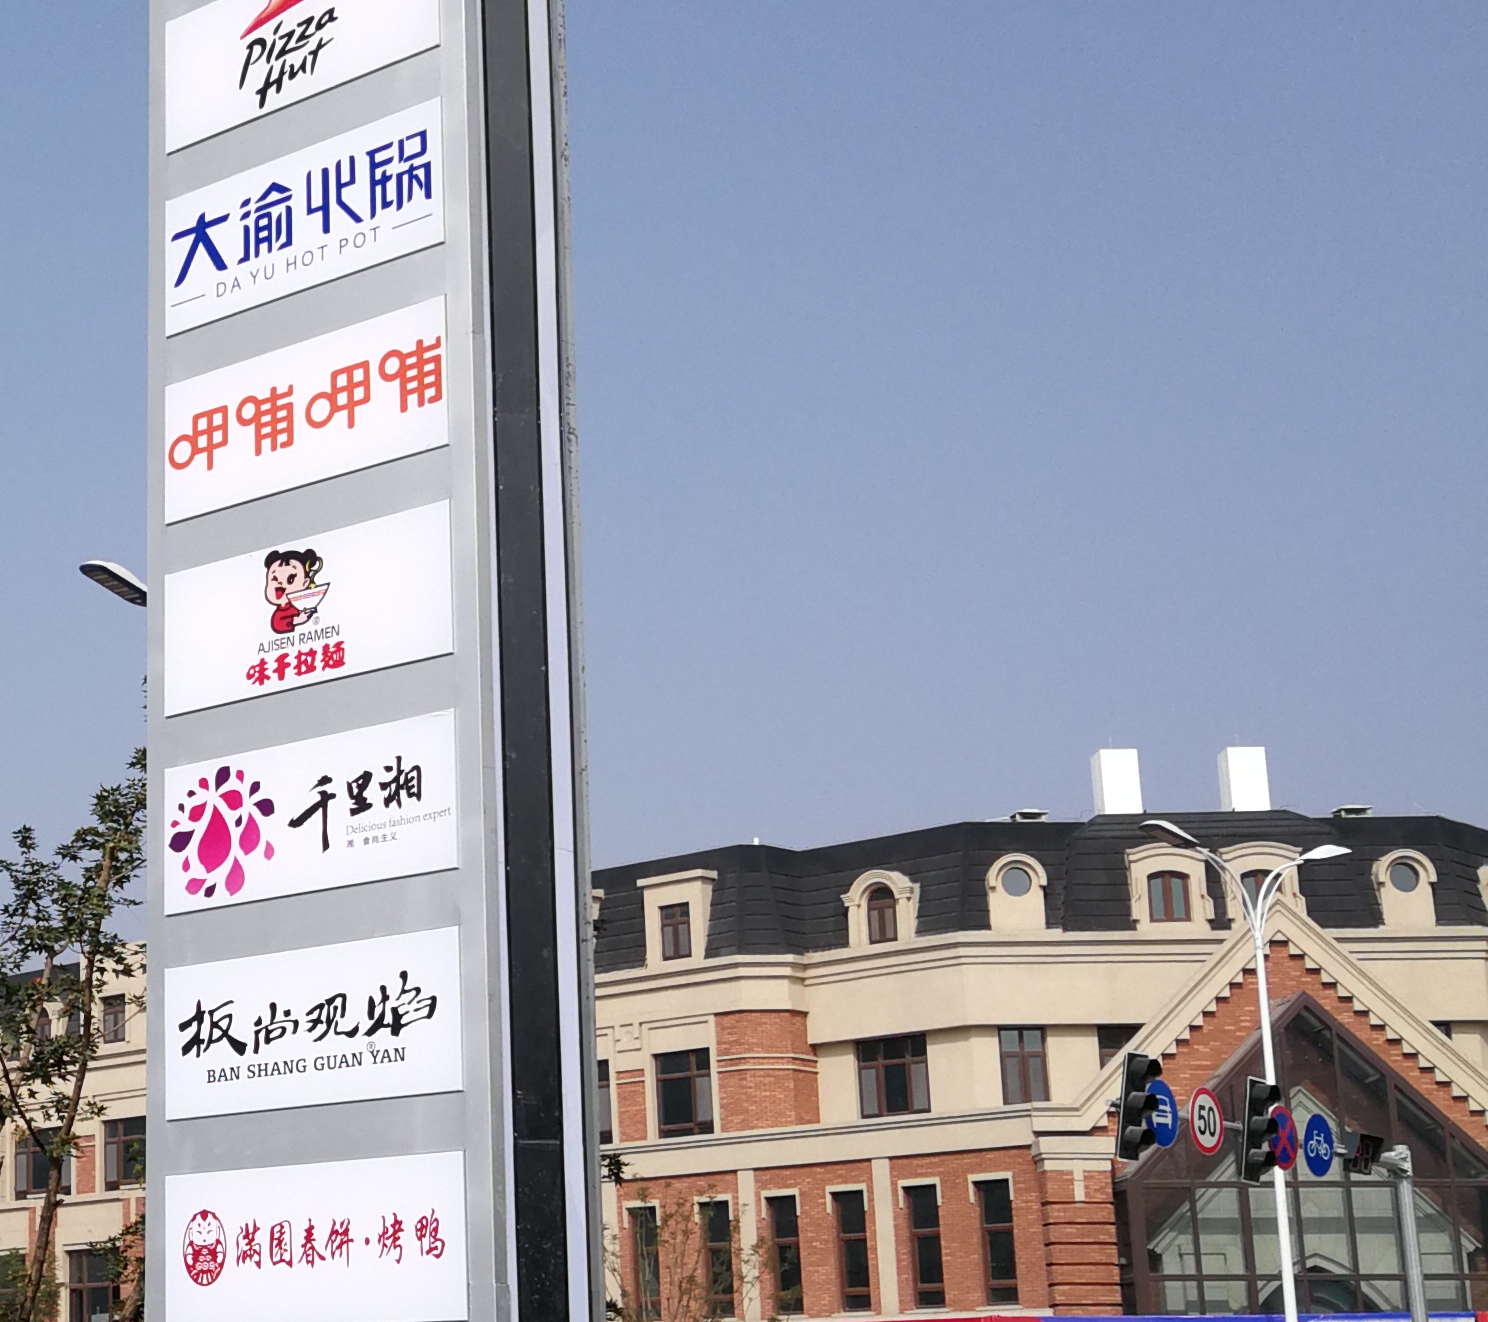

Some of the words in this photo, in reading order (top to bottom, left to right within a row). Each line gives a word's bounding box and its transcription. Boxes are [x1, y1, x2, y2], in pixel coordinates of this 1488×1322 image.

[239, 7, 338, 90] Pizza
[255, 38, 335, 110] Hut
[171, 129, 433, 289] 大渝火锅
[215, 277, 242, 299] DA
[249, 265, 276, 286] YU
[285, 244, 329, 273] HOT
[338, 226, 381, 255] POT
[168, 336, 443, 471] 呷哺呷哺
[257, 635, 295, 656] AJISEN
[298, 623, 341, 646] RAMEN
[287, 755, 423, 854] 千里湘
[345, 820, 388, 836] Delicious
[388, 815, 421, 828] fashion
[422, 807, 452, 823] expert
[206, 1065, 241, 1083] BAN
[246, 1058, 308, 1079] SHANG
[312, 1051, 364, 1072] GUAN
[370, 1046, 407, 1066] YAN
[1197, 1104, 1217, 1138] 50
